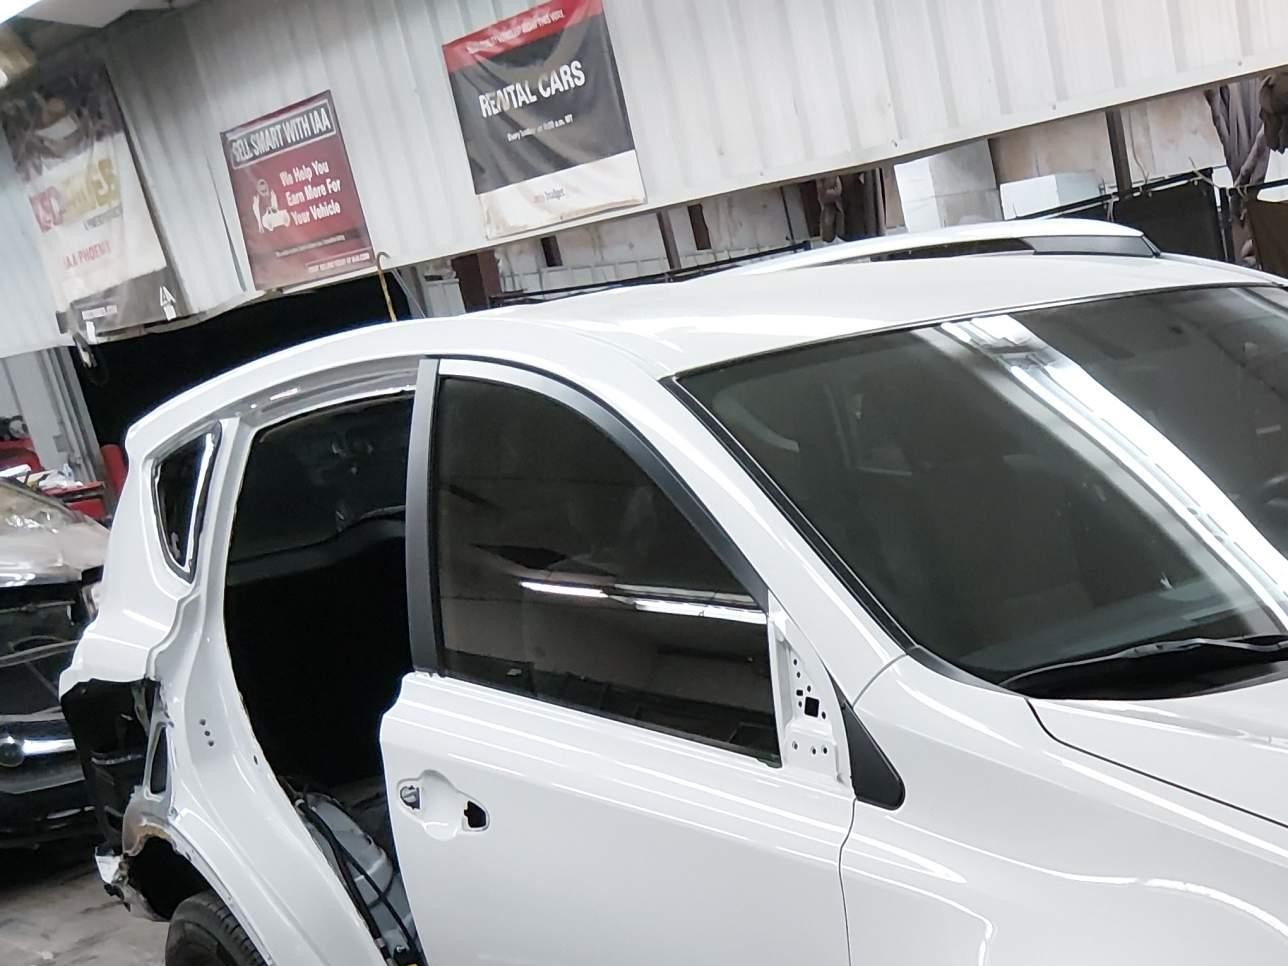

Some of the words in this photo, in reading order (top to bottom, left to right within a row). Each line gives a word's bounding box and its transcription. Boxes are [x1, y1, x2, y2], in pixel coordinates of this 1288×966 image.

[479, 80, 537, 119] RENTAL
[538, 60, 586, 98] CARS
[251, 125, 284, 156] SMART
[282, 114, 312, 144] WITH
[309, 107, 332, 135] IAA
[292, 165, 312, 183] Help
[311, 160, 330, 176] You
[285, 191, 305, 207] Earn
[304, 184, 327, 200] More
[326, 178, 341, 194] For
[290, 211, 310, 226] Your
[309, 199, 341, 220] Vehicle
